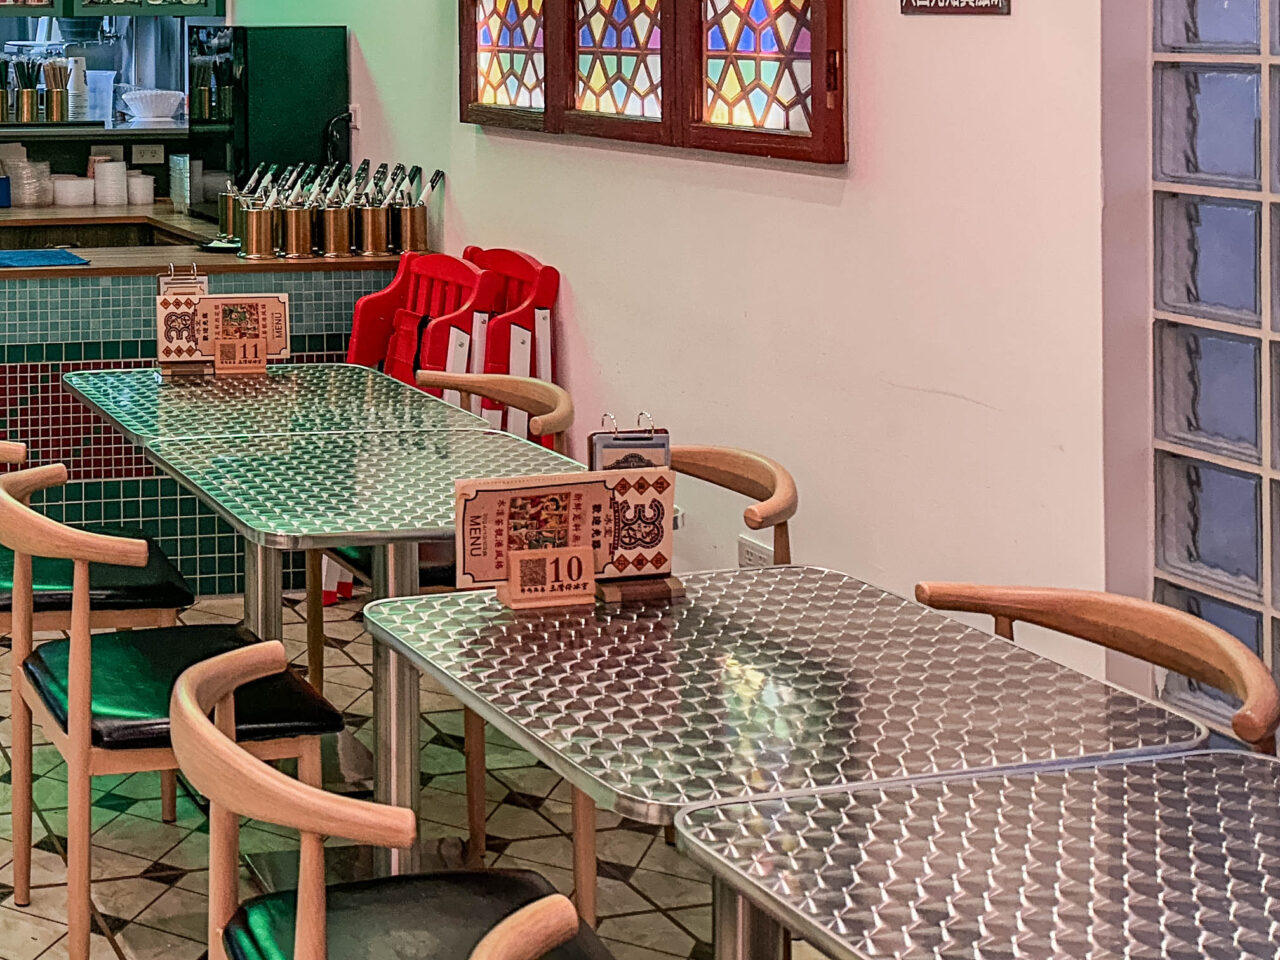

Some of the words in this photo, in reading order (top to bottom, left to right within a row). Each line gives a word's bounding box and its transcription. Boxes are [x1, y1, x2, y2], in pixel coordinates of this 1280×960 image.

[240, 343, 259, 359] 11
[470, 515, 481, 558] MENU
[550, 556, 583, 584] 10
